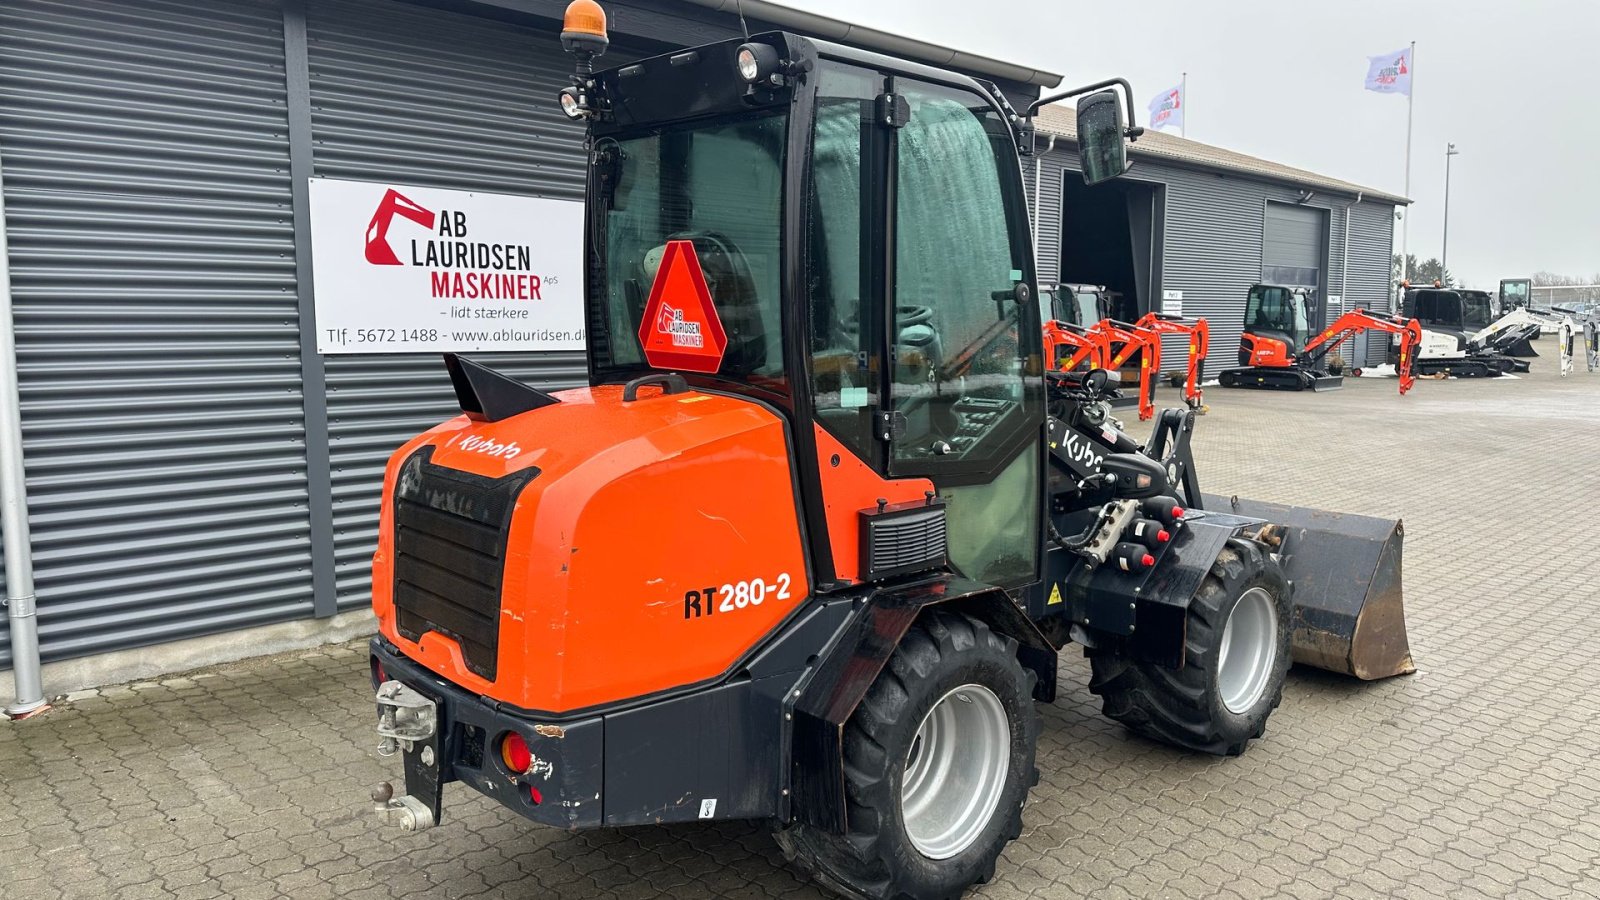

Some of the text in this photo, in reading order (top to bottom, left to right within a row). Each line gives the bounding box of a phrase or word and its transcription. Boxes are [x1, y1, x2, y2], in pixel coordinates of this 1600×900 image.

[439, 210, 467, 238] AB
[411, 239, 530, 271] LAURIDSEN
[431, 271, 558, 300] MASKINER ApS
[451, 306, 471, 319] lidt
[474, 307, 529, 319] stærkere
[675, 311, 682, 321] AB
[326, 329, 352, 346] Tlf.
[357, 329, 396, 342] 5672
[401, 329, 438, 342] 1488
[669, 322, 700, 334] LAURIDSEN
[674, 334, 702, 346] MASKINER
[458, 434, 521, 459] Kubota
[1062, 429, 1104, 473] Kubo
[684, 572, 791, 619] RT280-2
